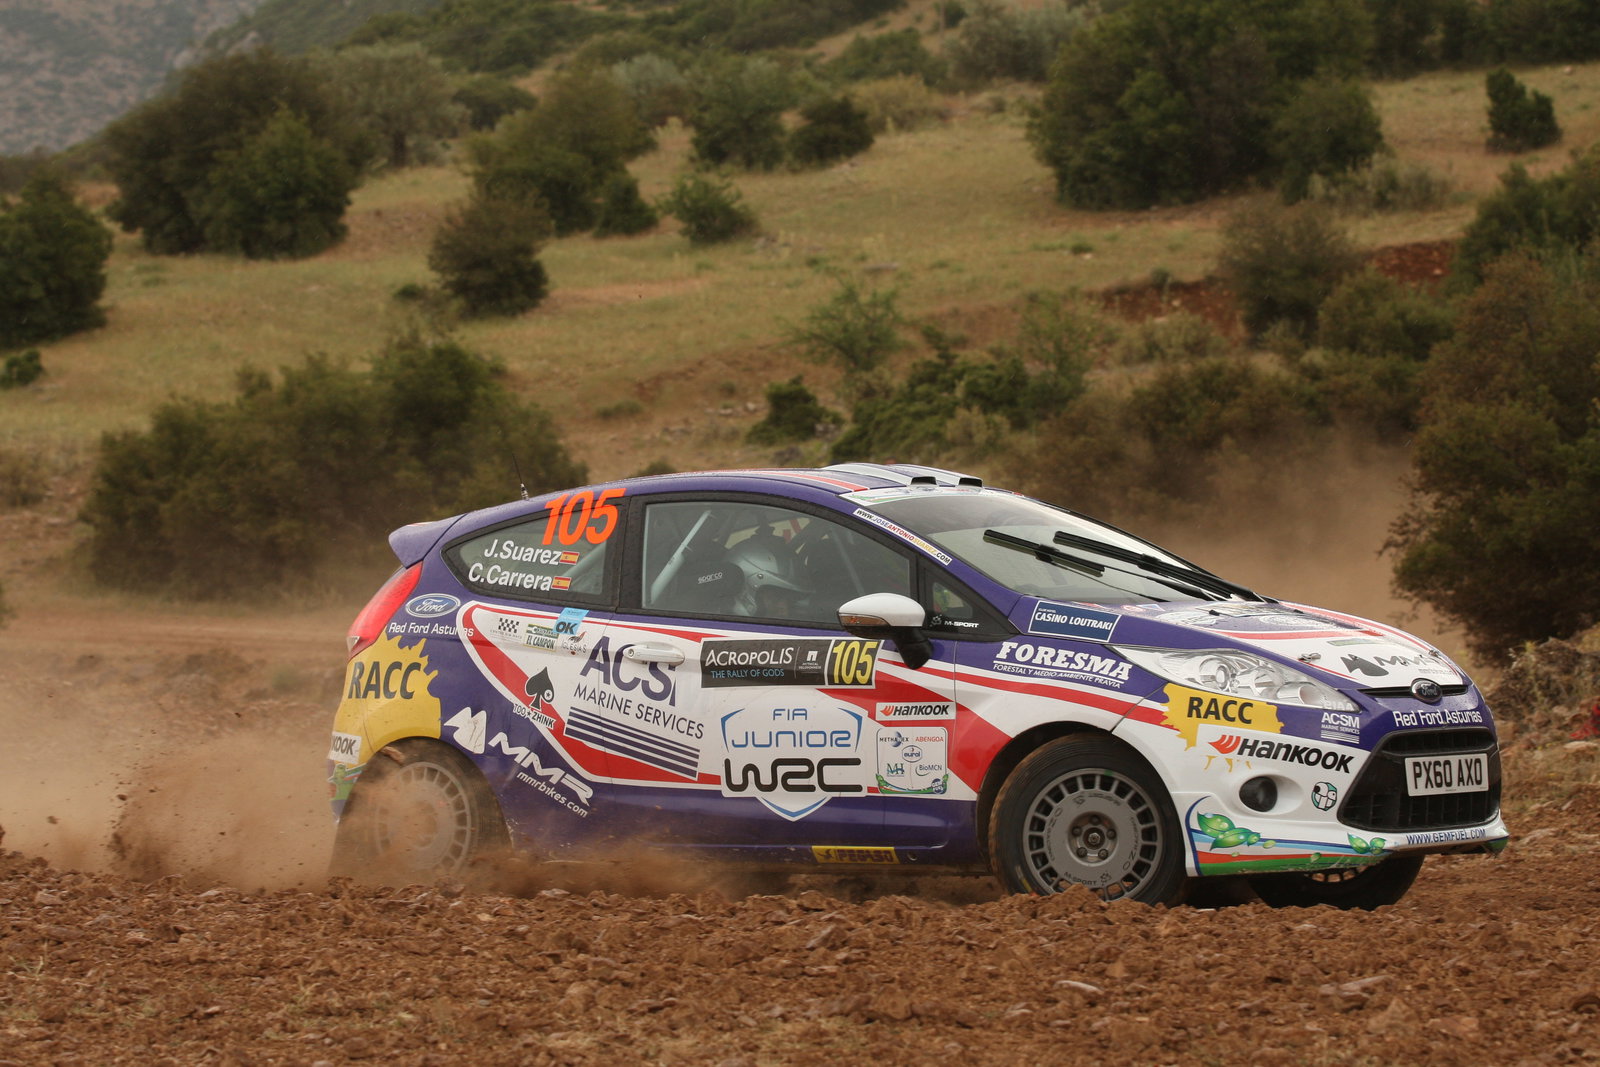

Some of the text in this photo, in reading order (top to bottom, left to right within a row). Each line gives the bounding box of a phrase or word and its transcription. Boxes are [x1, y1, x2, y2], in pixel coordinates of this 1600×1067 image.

[542, 489, 626, 545] 105
[484, 539, 562, 565] J.Suarez
[468, 563, 553, 591] C.Carrera
[415, 599, 448, 612] Ford
[388, 622, 407, 634] Red
[408, 623, 430, 634] Ford
[556, 622, 577, 635] OK
[1035, 612, 1114, 631] CASINO LOUTRAKI
[704, 647, 795, 667] ACROPOLIS
[832, 641, 878, 685] 105
[995, 641, 1133, 681] FORESMA
[710, 668, 785, 679] THE RALLY OF GODS
[993, 663, 1026, 675] FORESTAL
[348, 661, 421, 699] RACC
[532, 711, 554, 728] ZHINK
[573, 682, 705, 740] MARINE SERVICES
[773, 708, 808, 721] FIA
[1187, 697, 1254, 724] RACC
[1321, 712, 1360, 729] ACSM
[1393, 709, 1483, 727] Red Ford Asturias
[731, 731, 851, 748] JUNIOR
[488, 731, 593, 806] MMR
[724, 757, 863, 793] WRC
[1413, 758, 1483, 790] PX60 AXO
[516, 771, 588, 819] mmrbikes.com
[1406, 828, 1486, 845] WWW.GEMFUEL.COM
